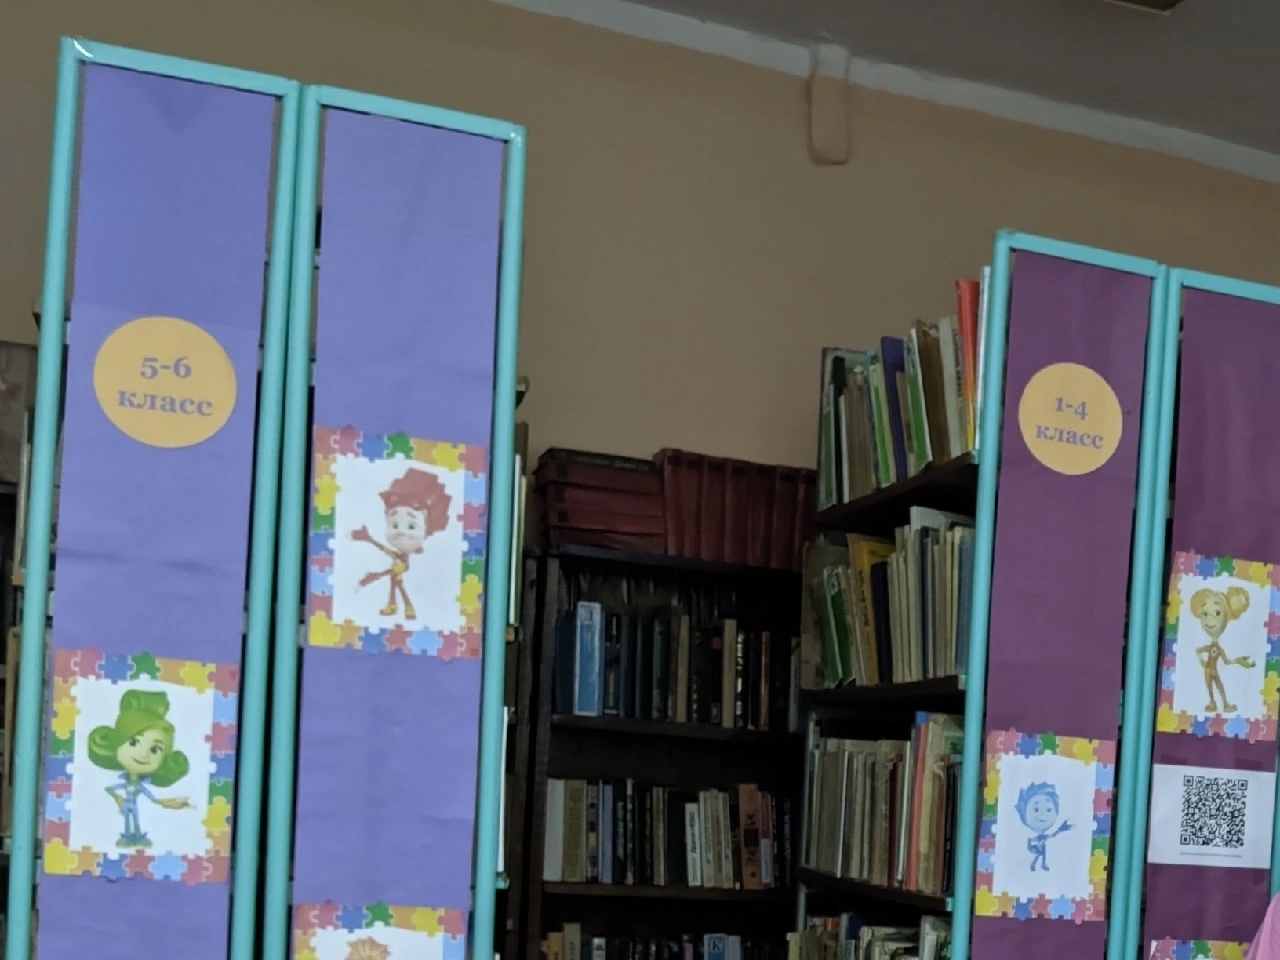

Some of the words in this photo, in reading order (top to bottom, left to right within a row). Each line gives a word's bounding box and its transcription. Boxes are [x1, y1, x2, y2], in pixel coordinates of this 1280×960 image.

[139, 356, 192, 380] 5-6
[117, 390, 214, 418] класс
[1054, 397, 1089, 421] 1-4
[1034, 423, 1104, 450] класс
